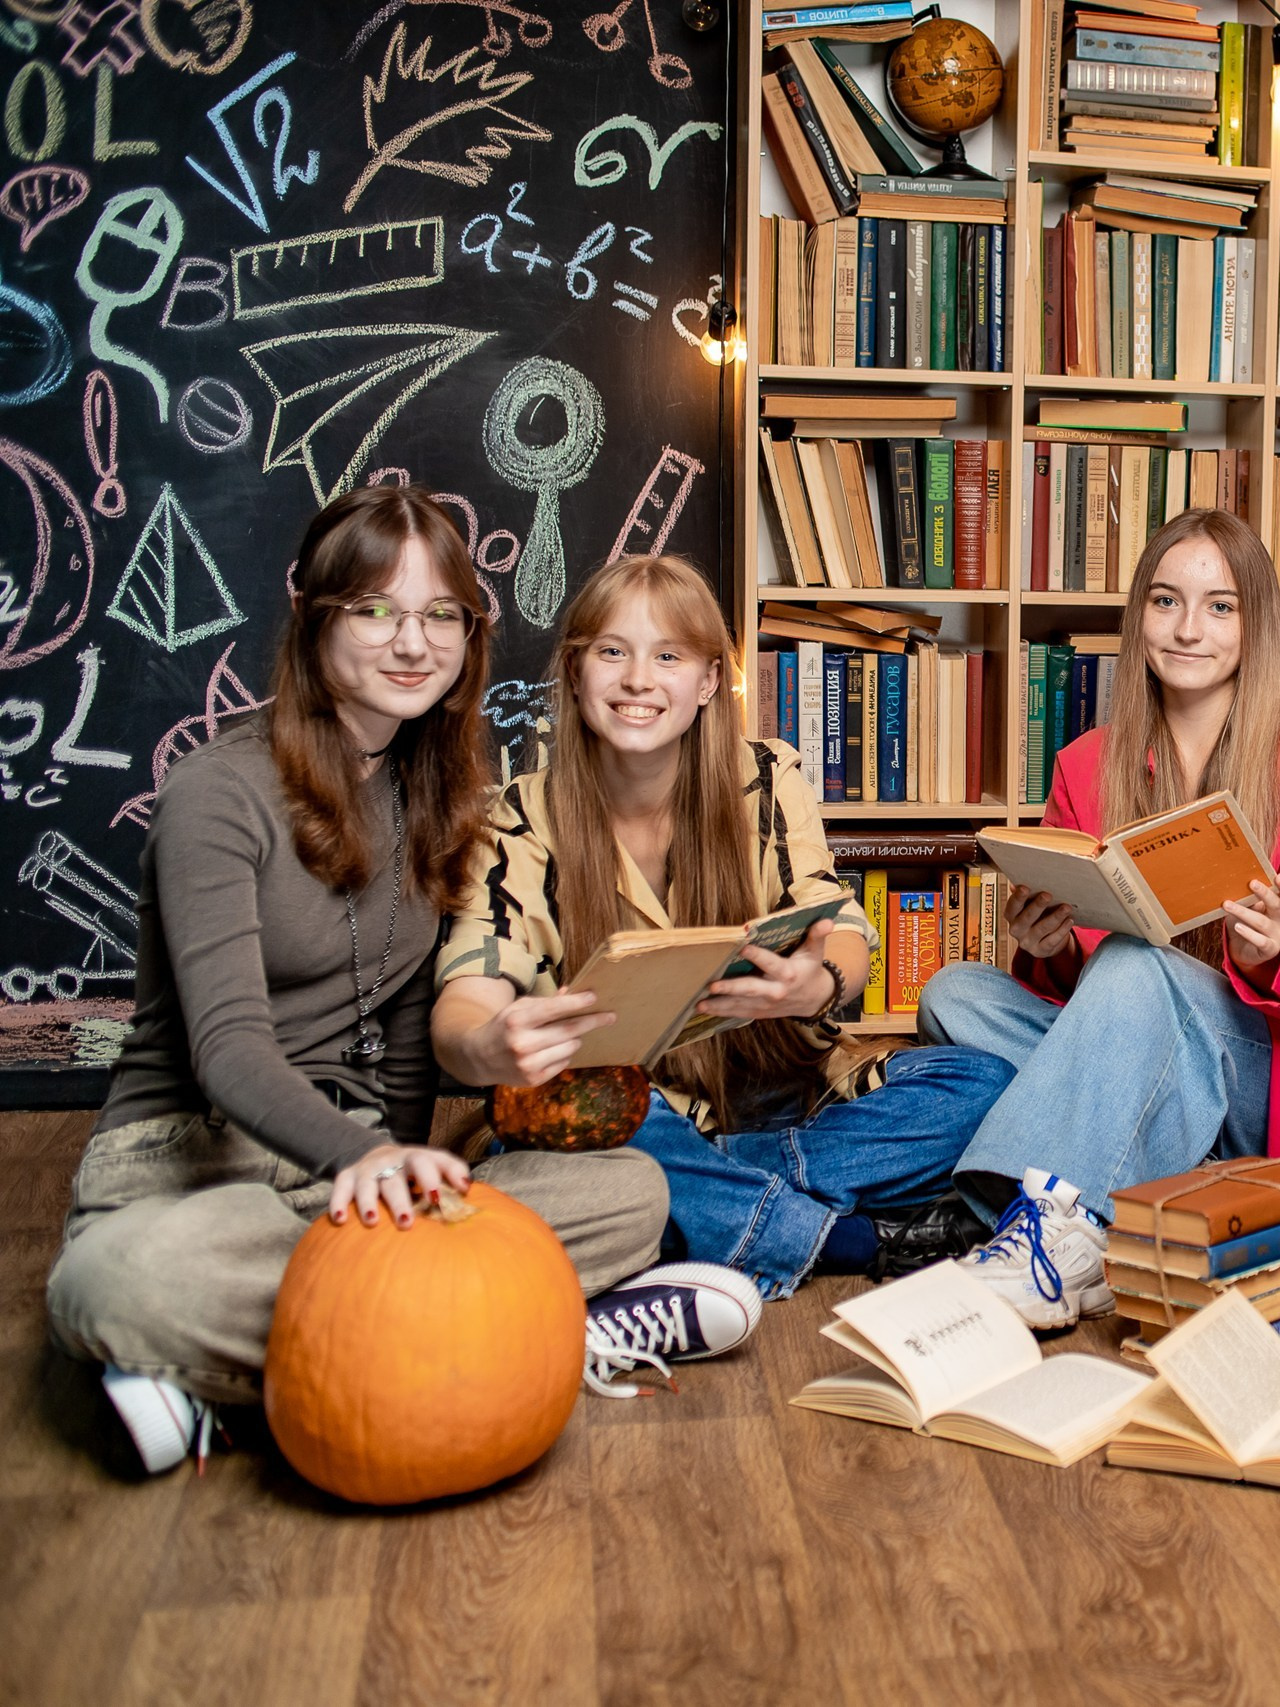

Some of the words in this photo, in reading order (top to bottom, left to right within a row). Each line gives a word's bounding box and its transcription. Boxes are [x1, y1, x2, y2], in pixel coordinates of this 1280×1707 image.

[809, 9, 848, 21] ШИТОВ
[1047, 46, 1057, 93] ЗАГАЛЬНА
[1045, 95, 1055, 141] БІОЛОГІЯ
[978, 235, 987, 266] ЛЮБОВЬ
[1225, 256, 1237, 297] МОРУА
[978, 285, 986, 326] АНЖЕЛИКА
[1223, 300, 1236, 342] АНДРЕ
[928, 451, 950, 502] біології
[987, 469, 1001, 500] ГІЛЕЯ
[1077, 457, 1085, 484] МОРЕМ
[1076, 485, 1084, 502] НАД
[1075, 503, 1083, 528] КРИЛА
[933, 516, 945, 568] ДОВІДНИК
[885, 665, 901, 735] ГУСАРОВ
[1020, 673, 1028, 704] КРАСИВИЙ
[1104, 662, 1113, 699] ФУНКЦИИ
[827, 669, 841, 736] ПОЗИЦИЯ
[1054, 690, 1065, 748] МИССИЯ
[827, 740, 835, 764] Юлиан
[834, 738, 842, 764] Семенов
[833, 846, 876, 857] ИВАНОВ
[878, 845, 936, 857] АНАТОЛИЙ
[1131, 827, 1201, 858] ФИЗИКА
[1111, 867, 1137, 906] ФИЗИКА
[985, 883, 995, 936] ЖИЗНИ
[898, 915, 906, 983] СОВРЕМЕННЫЙ
[919, 914, 936, 984] СЛОВАРЬ
[949, 913, 960, 960] ДЮМА
